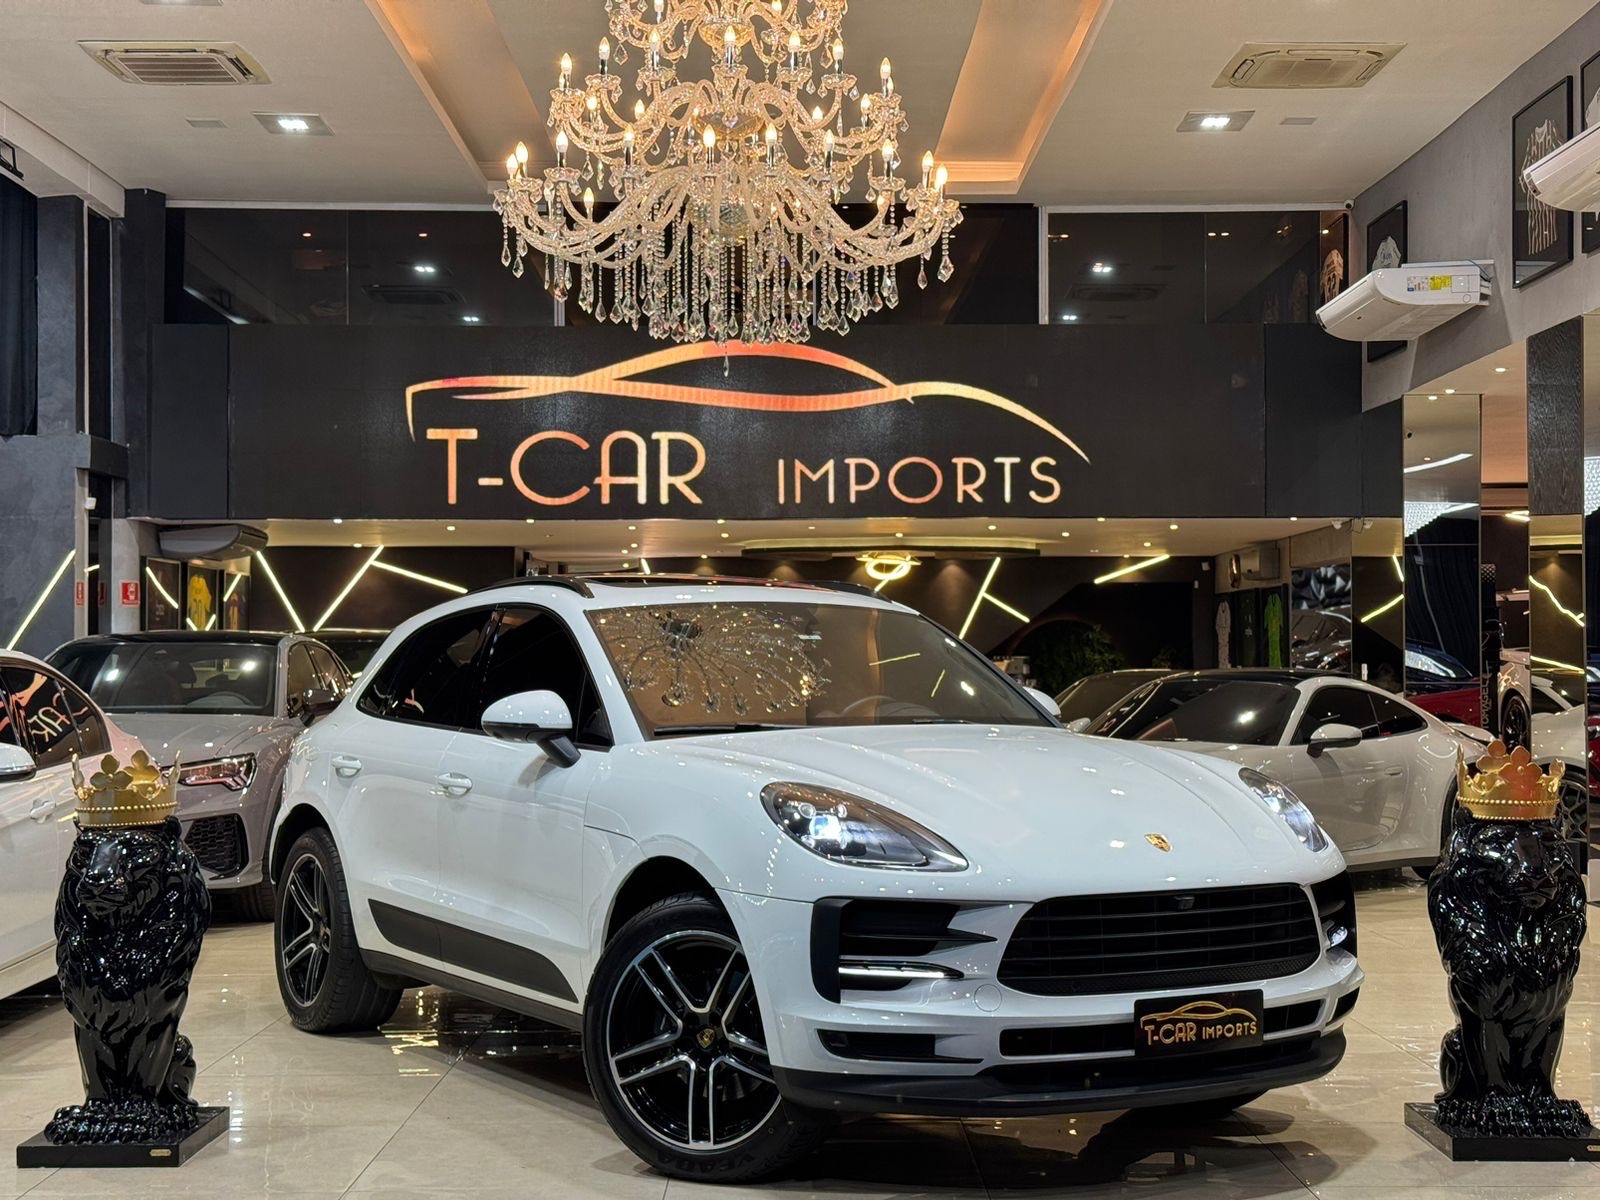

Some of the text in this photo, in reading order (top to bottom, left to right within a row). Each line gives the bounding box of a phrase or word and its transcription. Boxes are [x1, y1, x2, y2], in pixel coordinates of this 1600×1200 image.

[426, 429, 1062, 505] T-CAR IMPORTS
[1144, 1021, 1258, 1046] T-CAR IMPORTS
